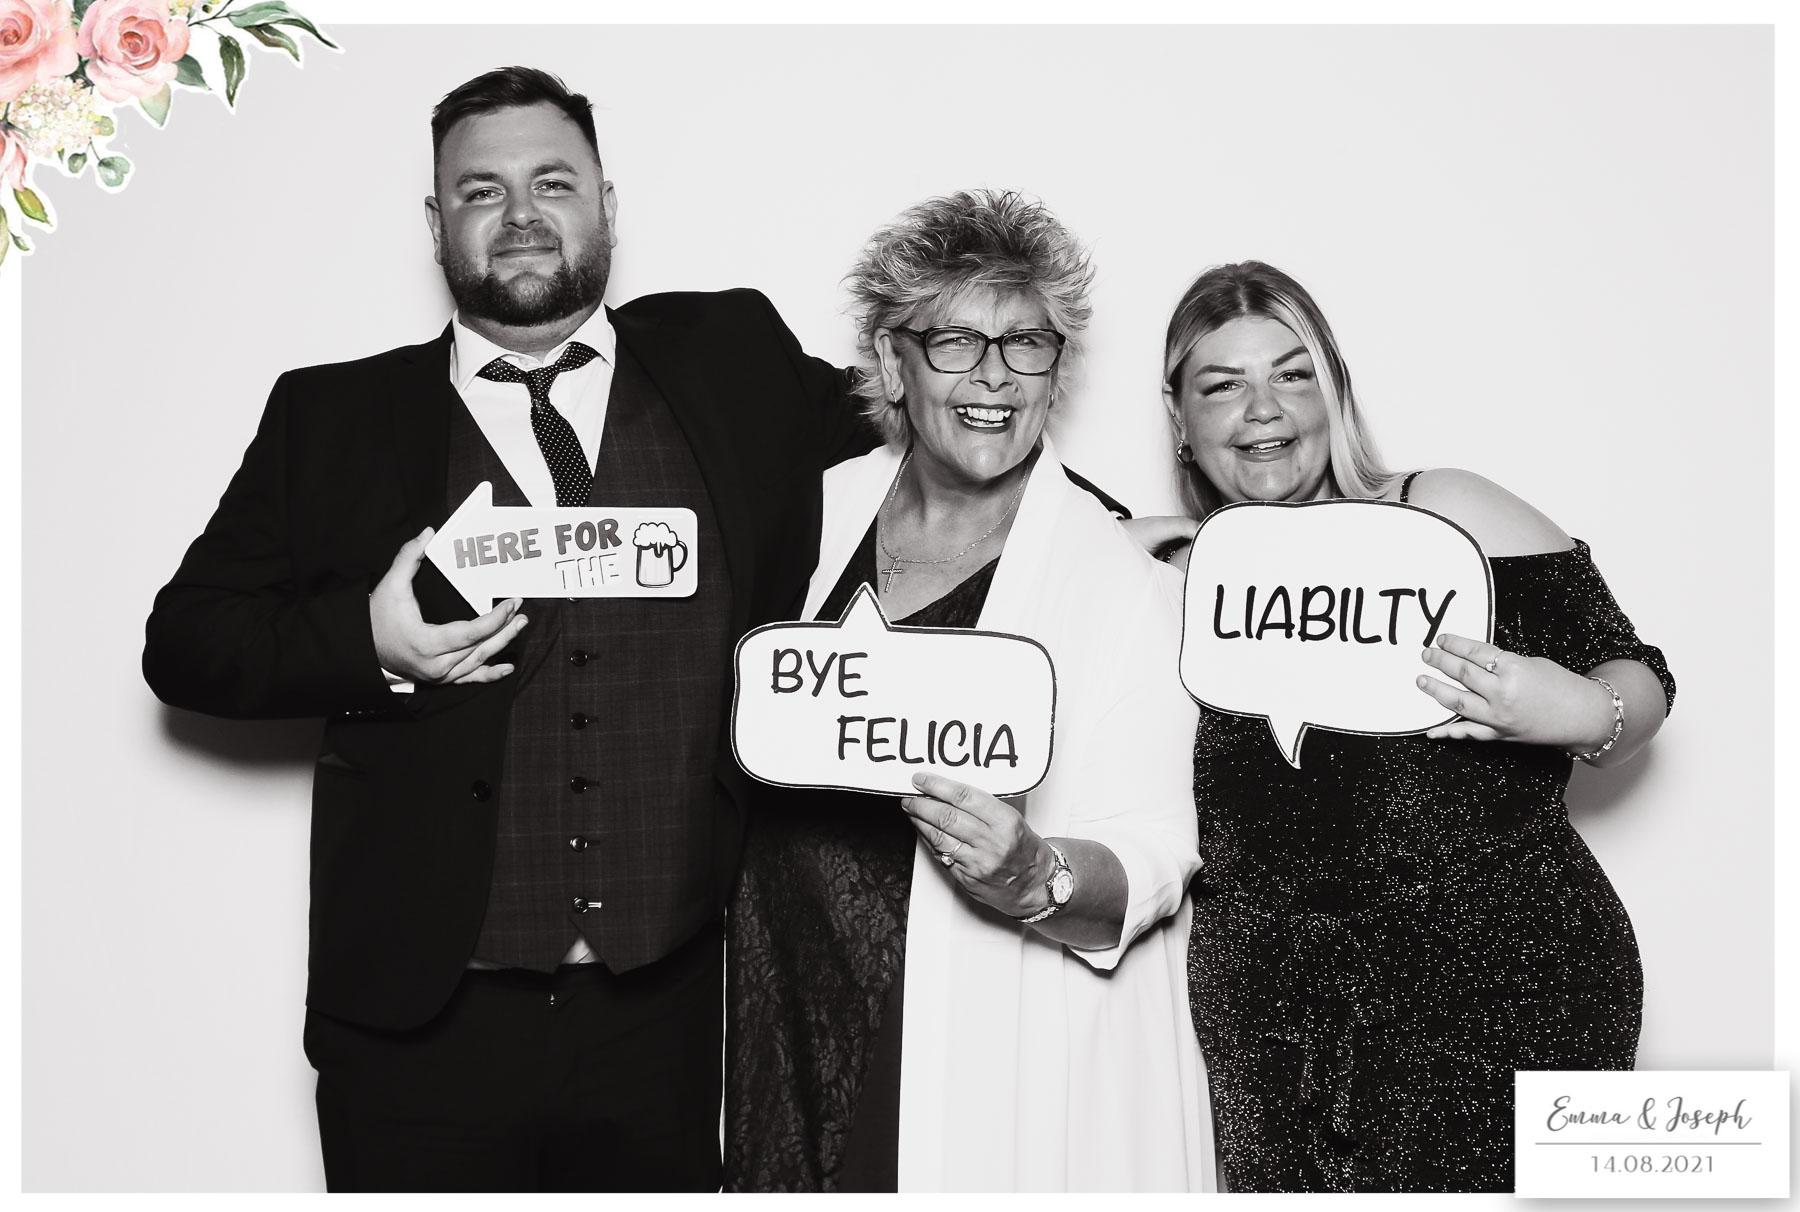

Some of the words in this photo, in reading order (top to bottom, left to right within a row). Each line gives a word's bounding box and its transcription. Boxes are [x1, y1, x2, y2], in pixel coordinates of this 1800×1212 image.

[453, 528, 542, 569] HERE
[554, 518, 623, 555] FOR
[554, 553, 621, 590] THE
[1213, 584, 1457, 648] LIABILTY
[771, 648, 869, 698] BYE
[837, 715, 1018, 768] FELICIA
